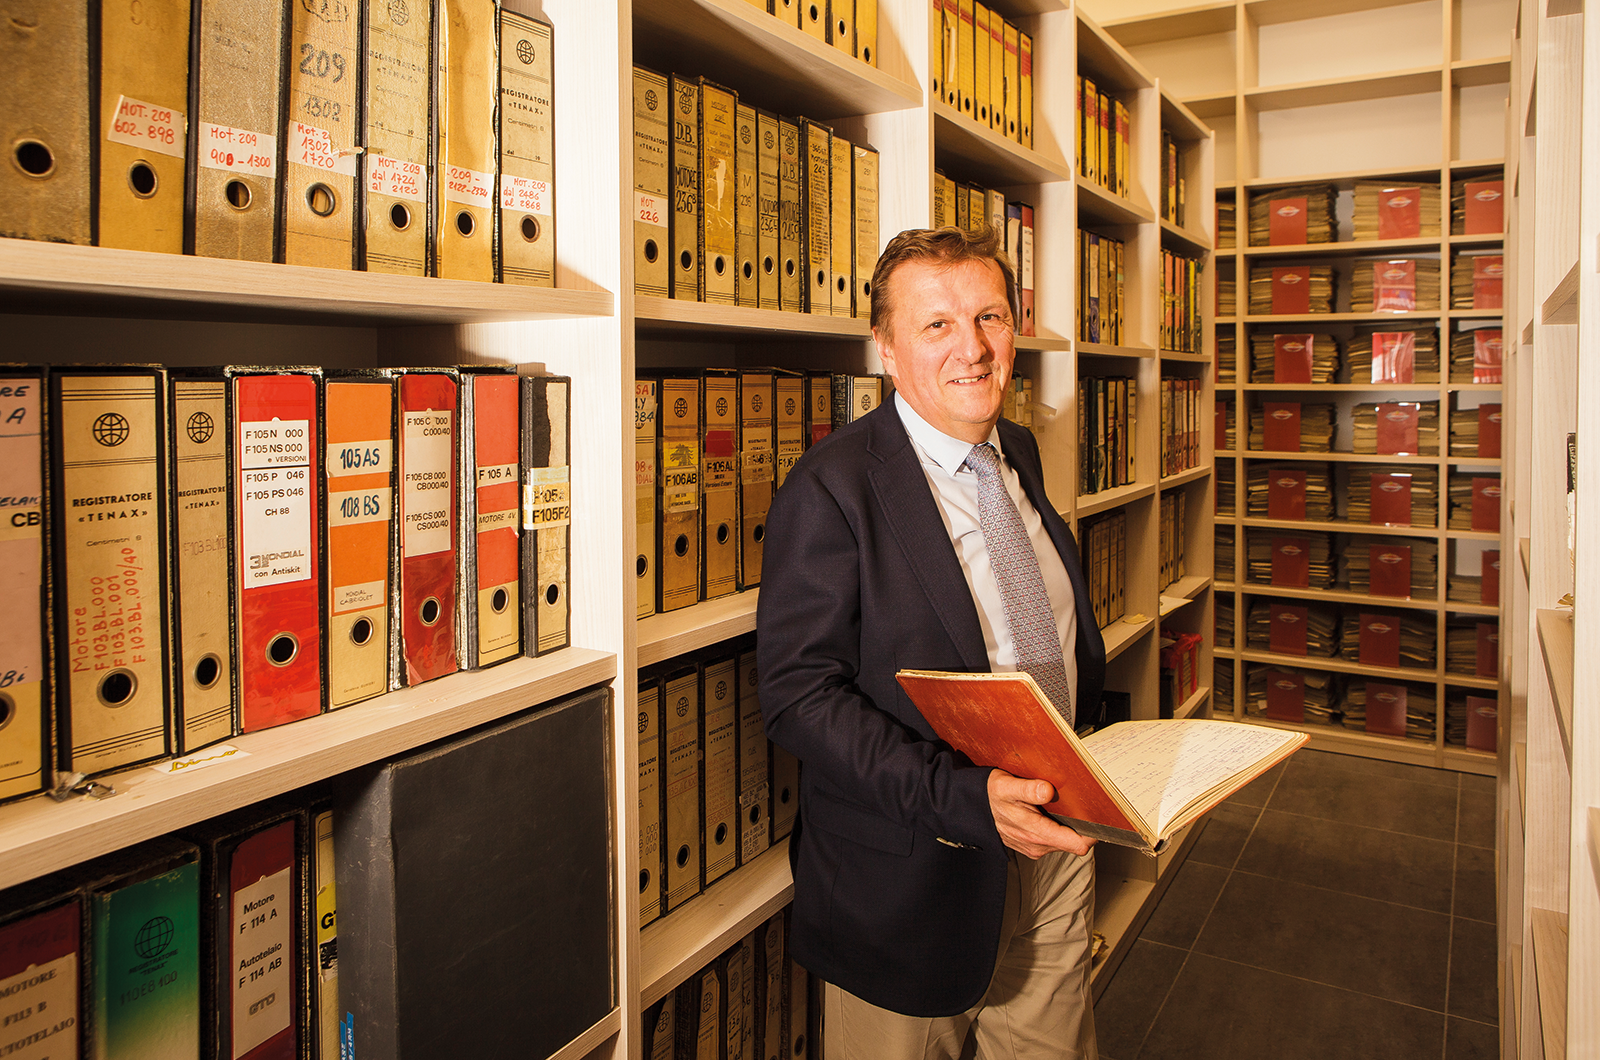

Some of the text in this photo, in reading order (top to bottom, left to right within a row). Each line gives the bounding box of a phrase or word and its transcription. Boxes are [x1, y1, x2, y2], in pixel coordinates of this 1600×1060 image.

[300, 43, 346, 83] 209
[502, 88, 550, 106] REGISTRATORE
[152, 109, 172, 124] 209
[304, 97, 341, 122] 1302
[148, 127, 175, 144] 898
[238, 132, 257, 146] 209
[636, 131, 668, 146] REGISTRATORE
[301, 136, 328, 154] 1302
[247, 154, 271, 168] 1300
[302, 150, 334, 169] 1720
[402, 163, 421, 175] 209
[372, 169, 416, 187] dal 1724
[372, 182, 418, 195] al 2120
[503, 186, 540, 200] dal 2486
[532, 182, 546, 192] 209
[520, 201, 541, 210] 2868
[640, 209, 659, 223] 226
[285, 429, 304, 438] 000
[286, 470, 304, 480] 046
[178, 486, 226, 498] REGISTRATORE
[286, 487, 304, 497] 046
[72, 492, 152, 508] REGISTRATORE
[340, 495, 380, 518] 108 BS
[265, 508, 278, 516] CH
[478, 513, 505, 524] MOTORE
[86, 536, 130, 547] Centimetri
[272, 566, 300, 576] Antiskit
[71, 606, 91, 673] Motore
[243, 893, 275, 915] Motore
[240, 908, 278, 934] F 114 A
[238, 942, 282, 972] Autotelaio
[238, 957, 282, 989] F 114 AB
[0, 968, 58, 999] MOTORE
